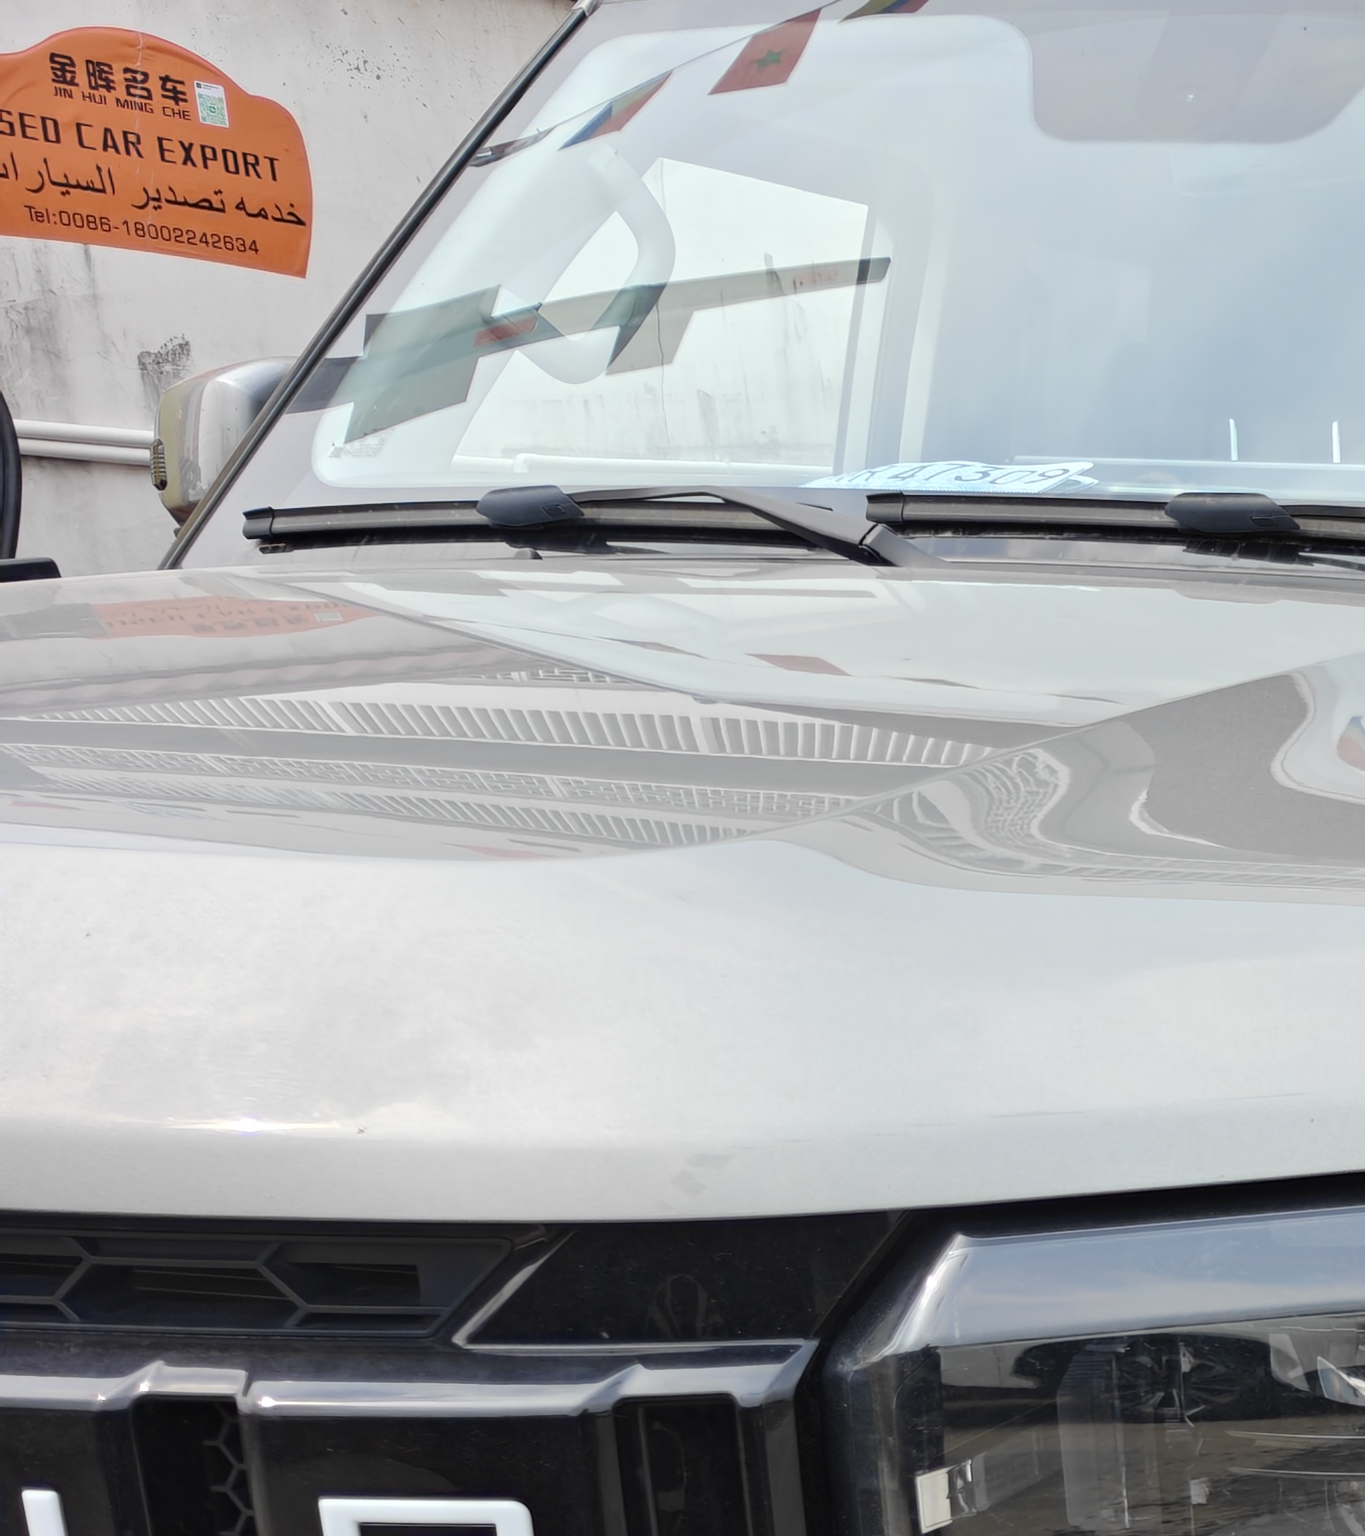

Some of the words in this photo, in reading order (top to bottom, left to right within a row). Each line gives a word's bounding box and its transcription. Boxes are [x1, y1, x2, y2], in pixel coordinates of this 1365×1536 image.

[49, 52, 189, 106] 金晖名车
[54, 86, 74, 99] JIN
[82, 91, 108, 105] HUI
[115, 97, 154, 114] MING
[162, 106, 192, 121] CHE
[76, 122, 144, 159] CAR
[156, 135, 280, 182] EXPORT
[24, 204, 260, 255] Tel:0086-18002242634
